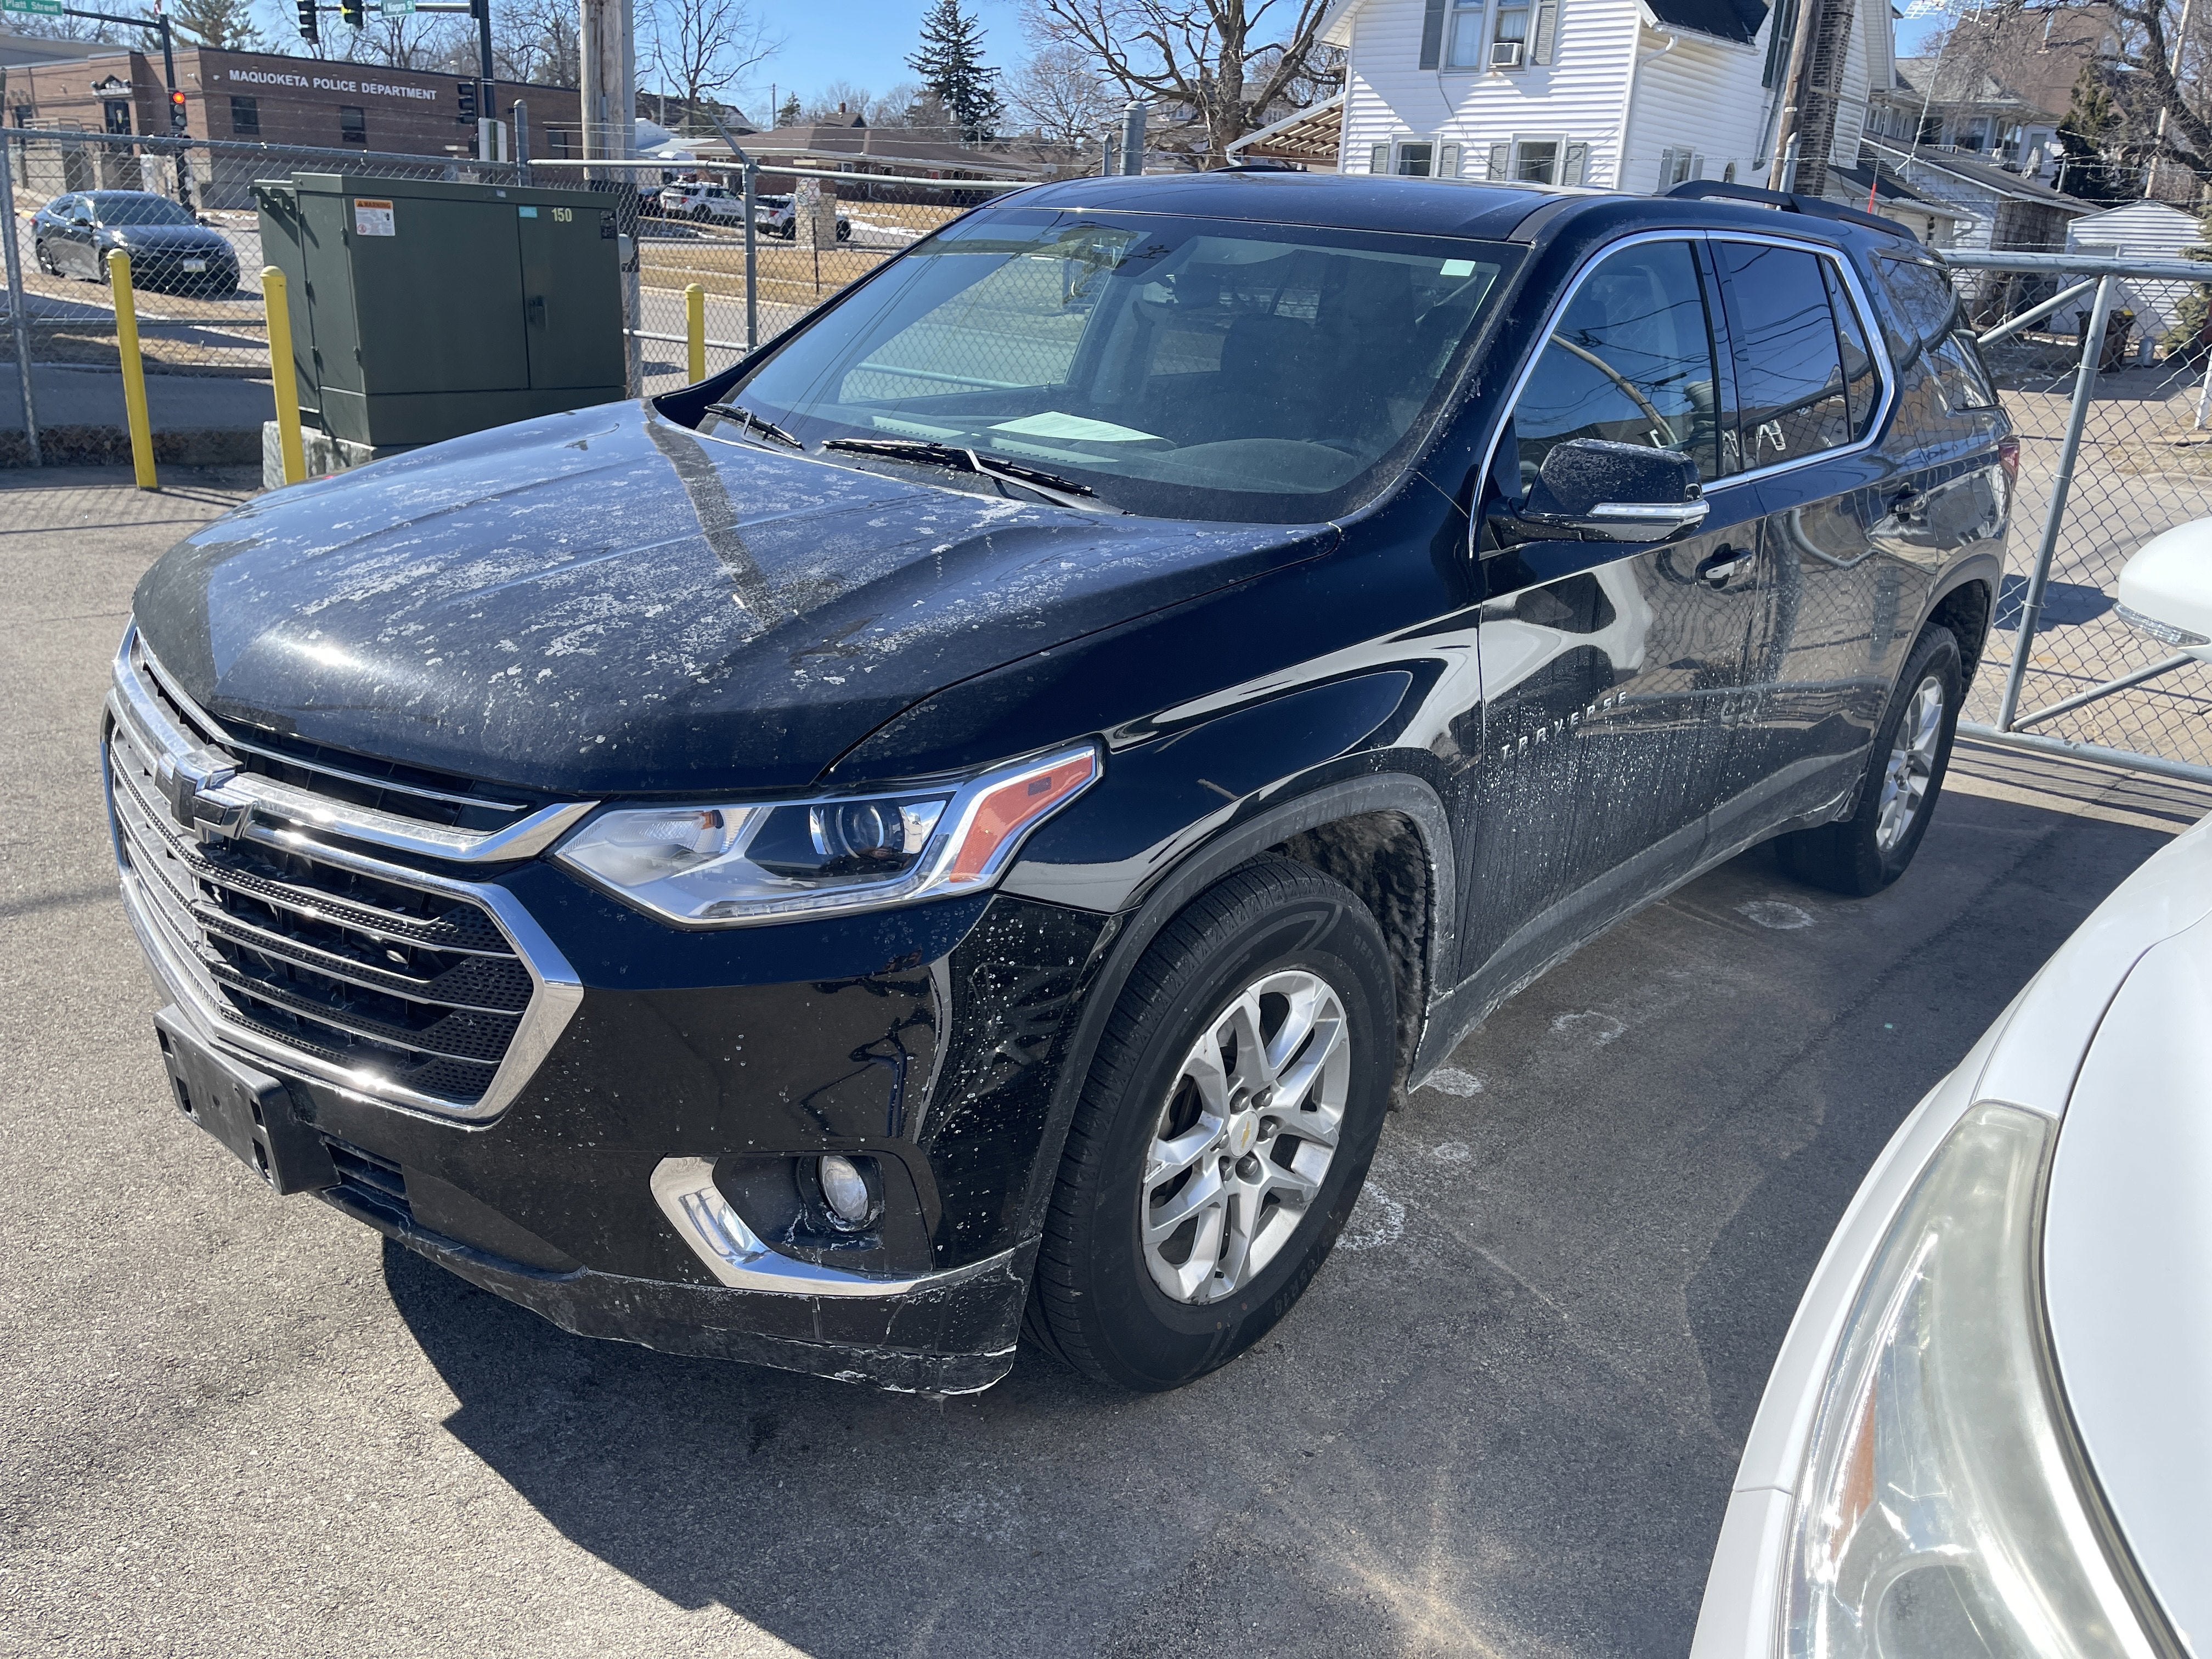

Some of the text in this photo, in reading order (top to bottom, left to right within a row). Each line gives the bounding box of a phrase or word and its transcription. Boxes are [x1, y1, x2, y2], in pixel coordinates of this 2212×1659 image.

[5, 0, 58, 12] Platt Street
[229, 69, 437, 100] MAQUOKETA POLICE DEPARTMENT
[551, 207, 572, 222] 150
[1502, 691, 1627, 760] TRAVERSE
